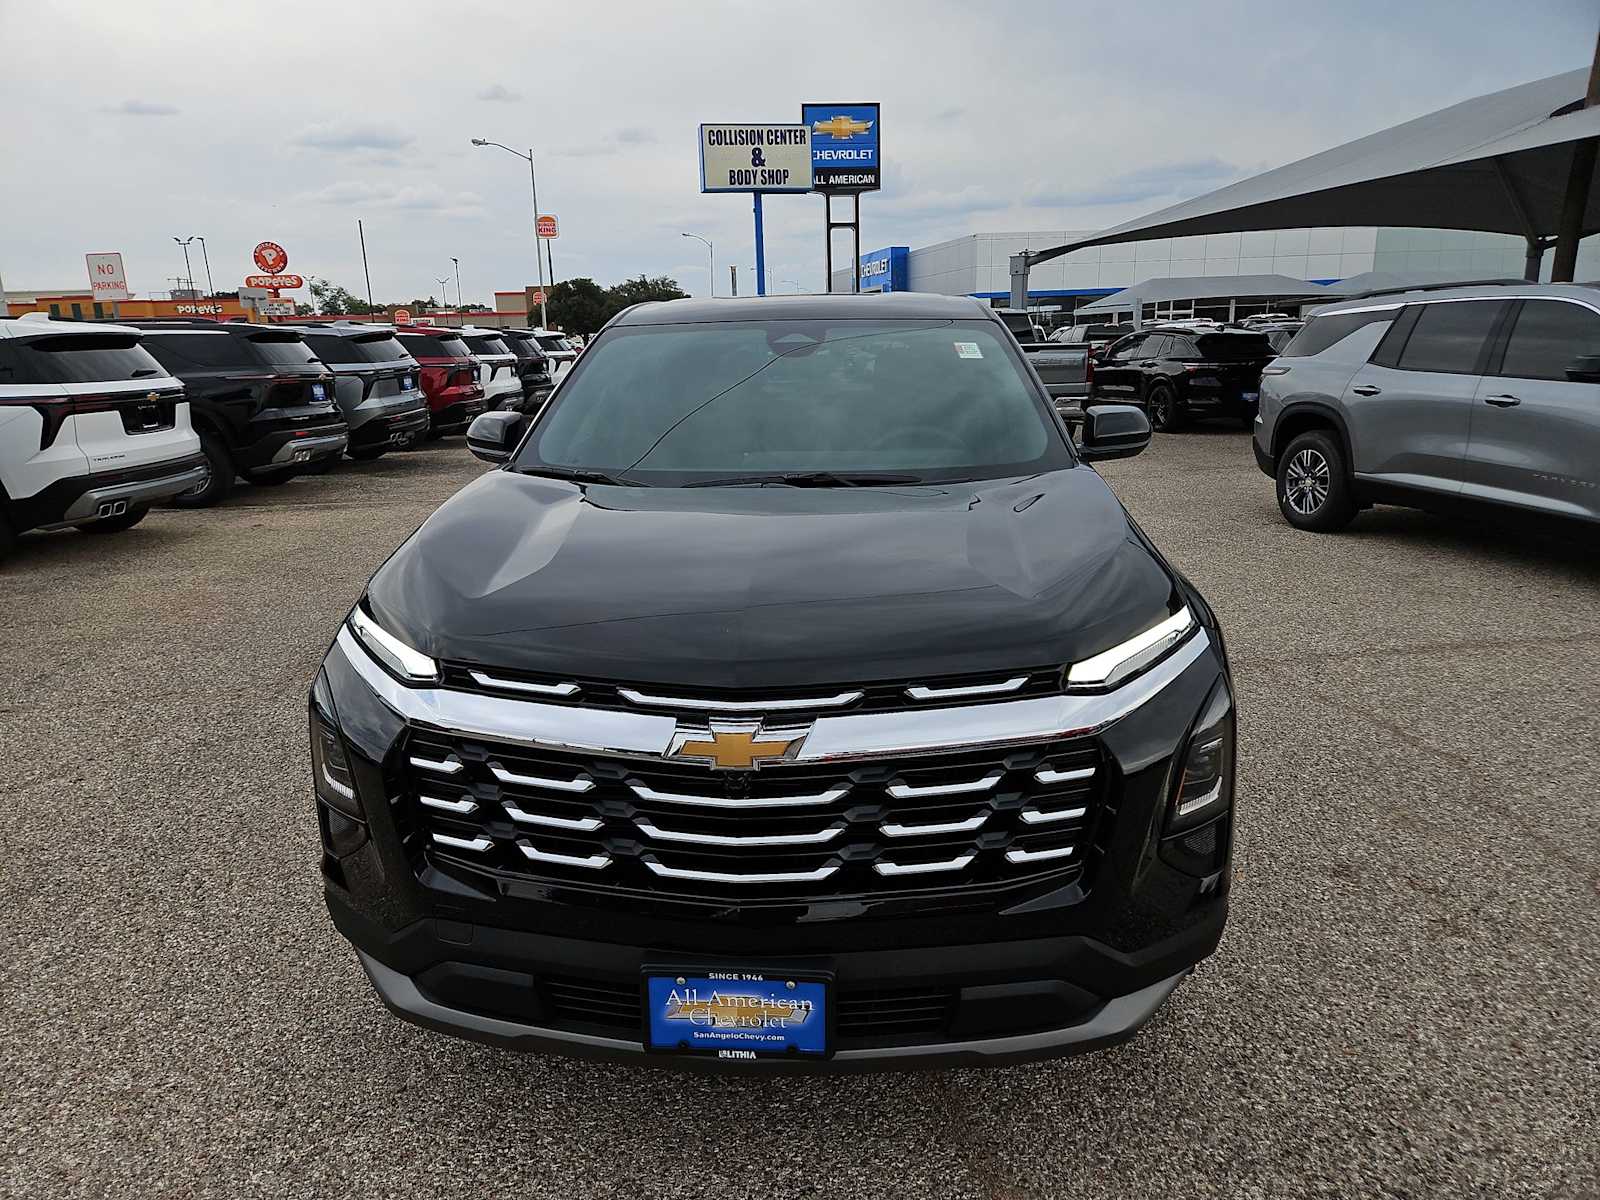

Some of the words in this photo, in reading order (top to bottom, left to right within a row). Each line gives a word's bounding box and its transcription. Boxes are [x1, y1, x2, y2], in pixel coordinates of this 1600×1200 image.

[708, 129, 764, 146] COLLISION
[766, 129, 807, 145] CENTER
[751, 147, 766, 167] &
[729, 169, 758, 186] BODY
[760, 169, 790, 185] SHOP
[828, 174, 876, 184] AMERICAN
[96, 264, 114, 275] NO
[92, 281, 126, 291] PARKING
[708, 972, 739, 981] SINCE
[741, 973, 764, 982] 1946
[665, 988, 698, 1006] All
[707, 989, 815, 1011] American
[689, 1007, 788, 1029] Chevrolet
[693, 1031, 785, 1042] SanAngeloChevy.com
[727, 1050, 757, 1059] LITHIA
